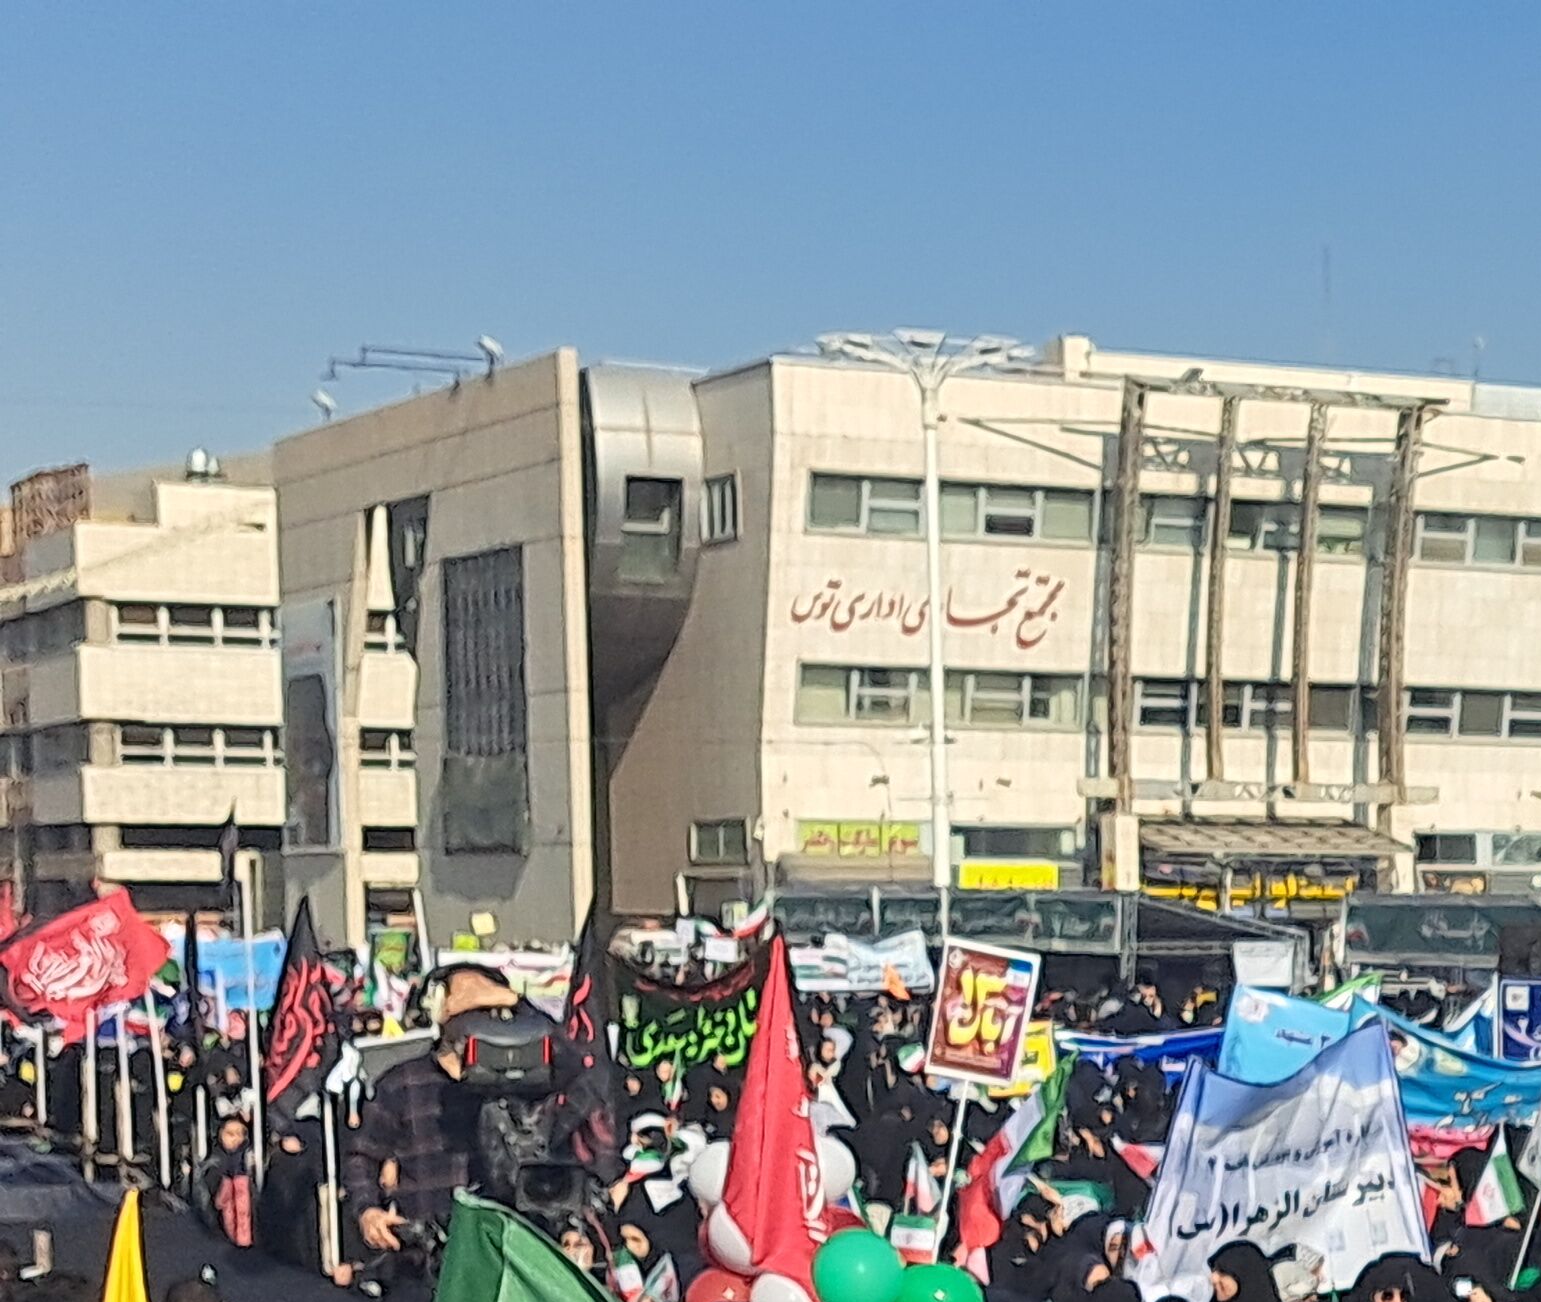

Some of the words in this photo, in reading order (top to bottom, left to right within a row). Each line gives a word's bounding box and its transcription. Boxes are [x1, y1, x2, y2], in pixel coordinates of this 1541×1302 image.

[790, 579, 842, 623] توس
[830, 591, 904, 632] اداری
[901, 567, 1031, 637] تجای
